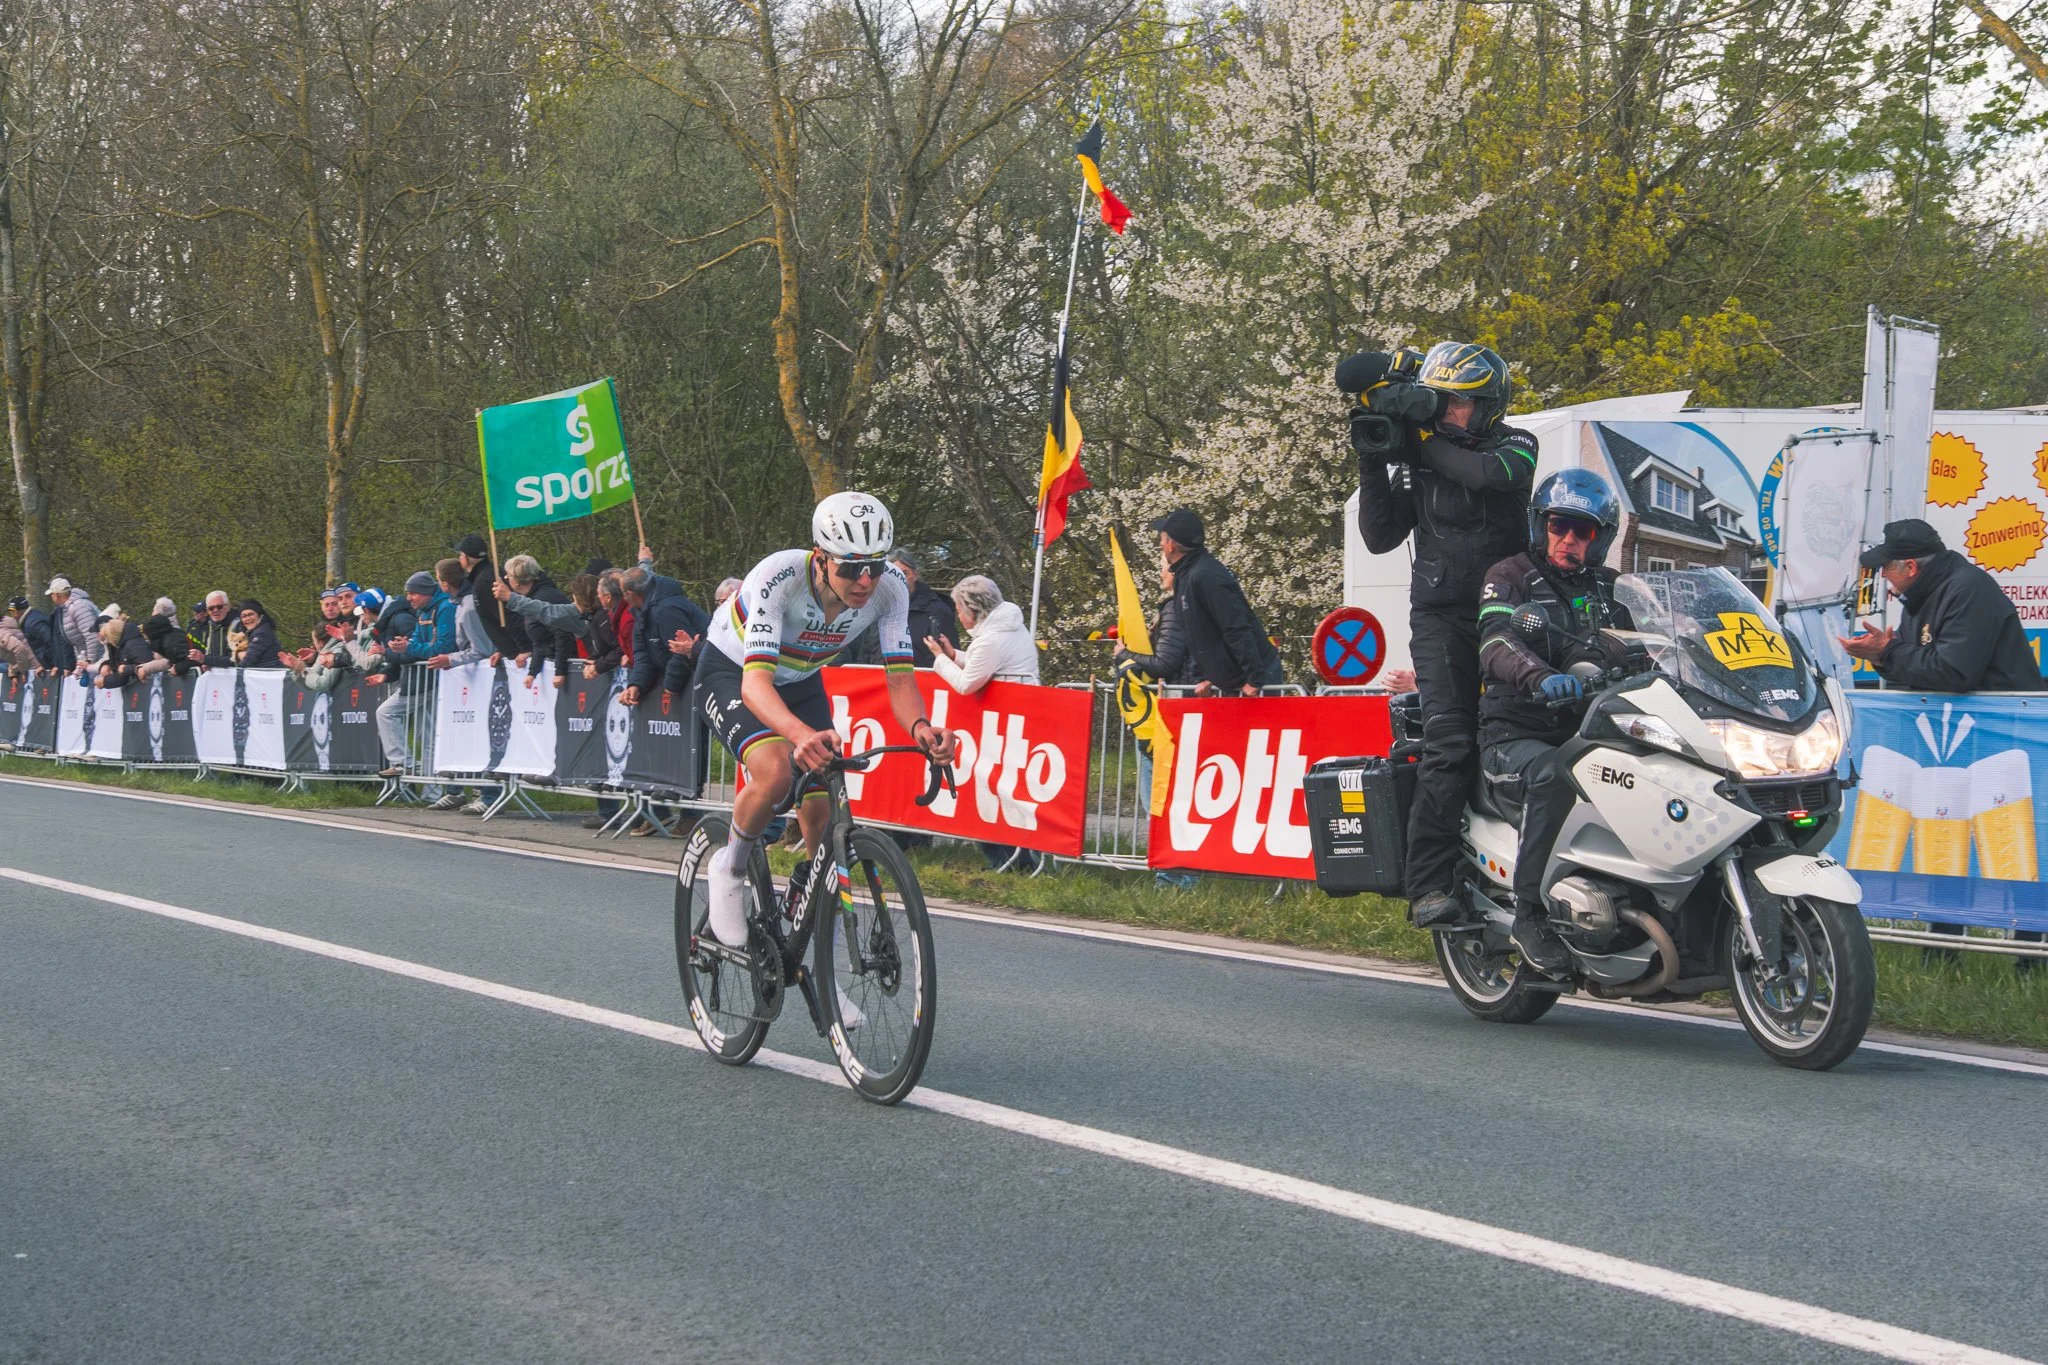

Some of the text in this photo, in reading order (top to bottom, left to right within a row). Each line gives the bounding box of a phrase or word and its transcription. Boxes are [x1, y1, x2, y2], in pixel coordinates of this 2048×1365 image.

[1431, 366, 1459, 379] JAN
[1931, 459, 1957, 479] Glas
[850, 505, 875, 517] G42
[1972, 521, 2040, 549] Zonwering
[767, 566, 796, 592] Analog
[1771, 689, 1799, 701] EMG
[342, 712, 368, 723] TUDOR
[568, 718, 593, 731] TUDOR
[648, 720, 681, 736] TUDOR
[924, 688, 1066, 830] lotto
[1169, 713, 1341, 858] lott
[1340, 772, 1359, 789] 077
[1601, 766, 1634, 789] EMG
[1338, 818, 1362, 834] EMG
[793, 843, 825, 931] COLNAGO
